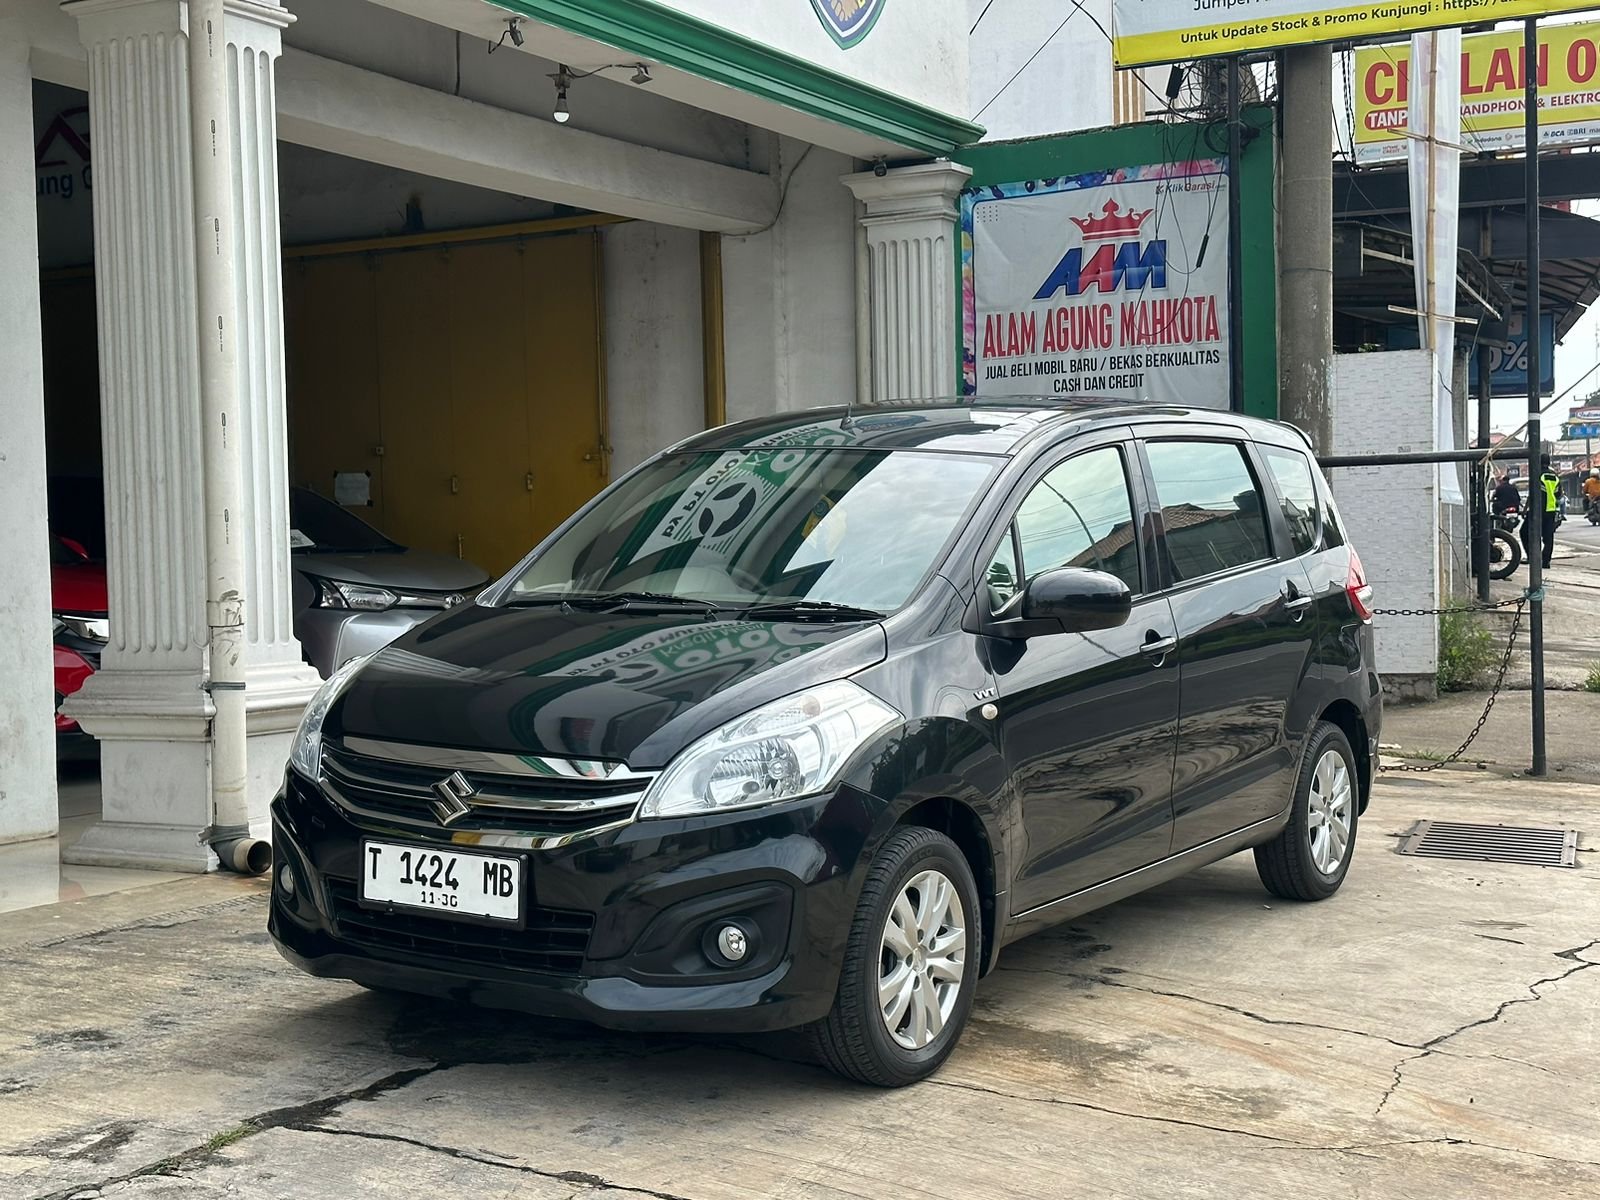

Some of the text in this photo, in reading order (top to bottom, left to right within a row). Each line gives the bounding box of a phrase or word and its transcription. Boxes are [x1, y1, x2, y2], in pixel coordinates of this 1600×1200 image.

[1181, 29, 1218, 43] Untuk
[1222, 23, 1268, 39] Update
[1272, 17, 1309, 32] Stock
[1312, 16, 1321, 27] &
[1324, 11, 1368, 26] Promo
[1371, 4, 1432, 19] Kunjungi
[1364, 43, 1549, 105] CILAN
[1460, 100, 1526, 116] ANDPHON
[1032, 240, 1167, 300] AAM
[982, 295, 1220, 359] ALAM AGUNG MAHKOTA
[985, 350, 1220, 380] JUAL BELI MOBIL BARU / BEKAS BERKUALITAS
[1053, 373, 1145, 393] CASH DAN CREDIT
[973, 687, 995, 700] VVT
[368, 846, 514, 898] T 1424 MB
